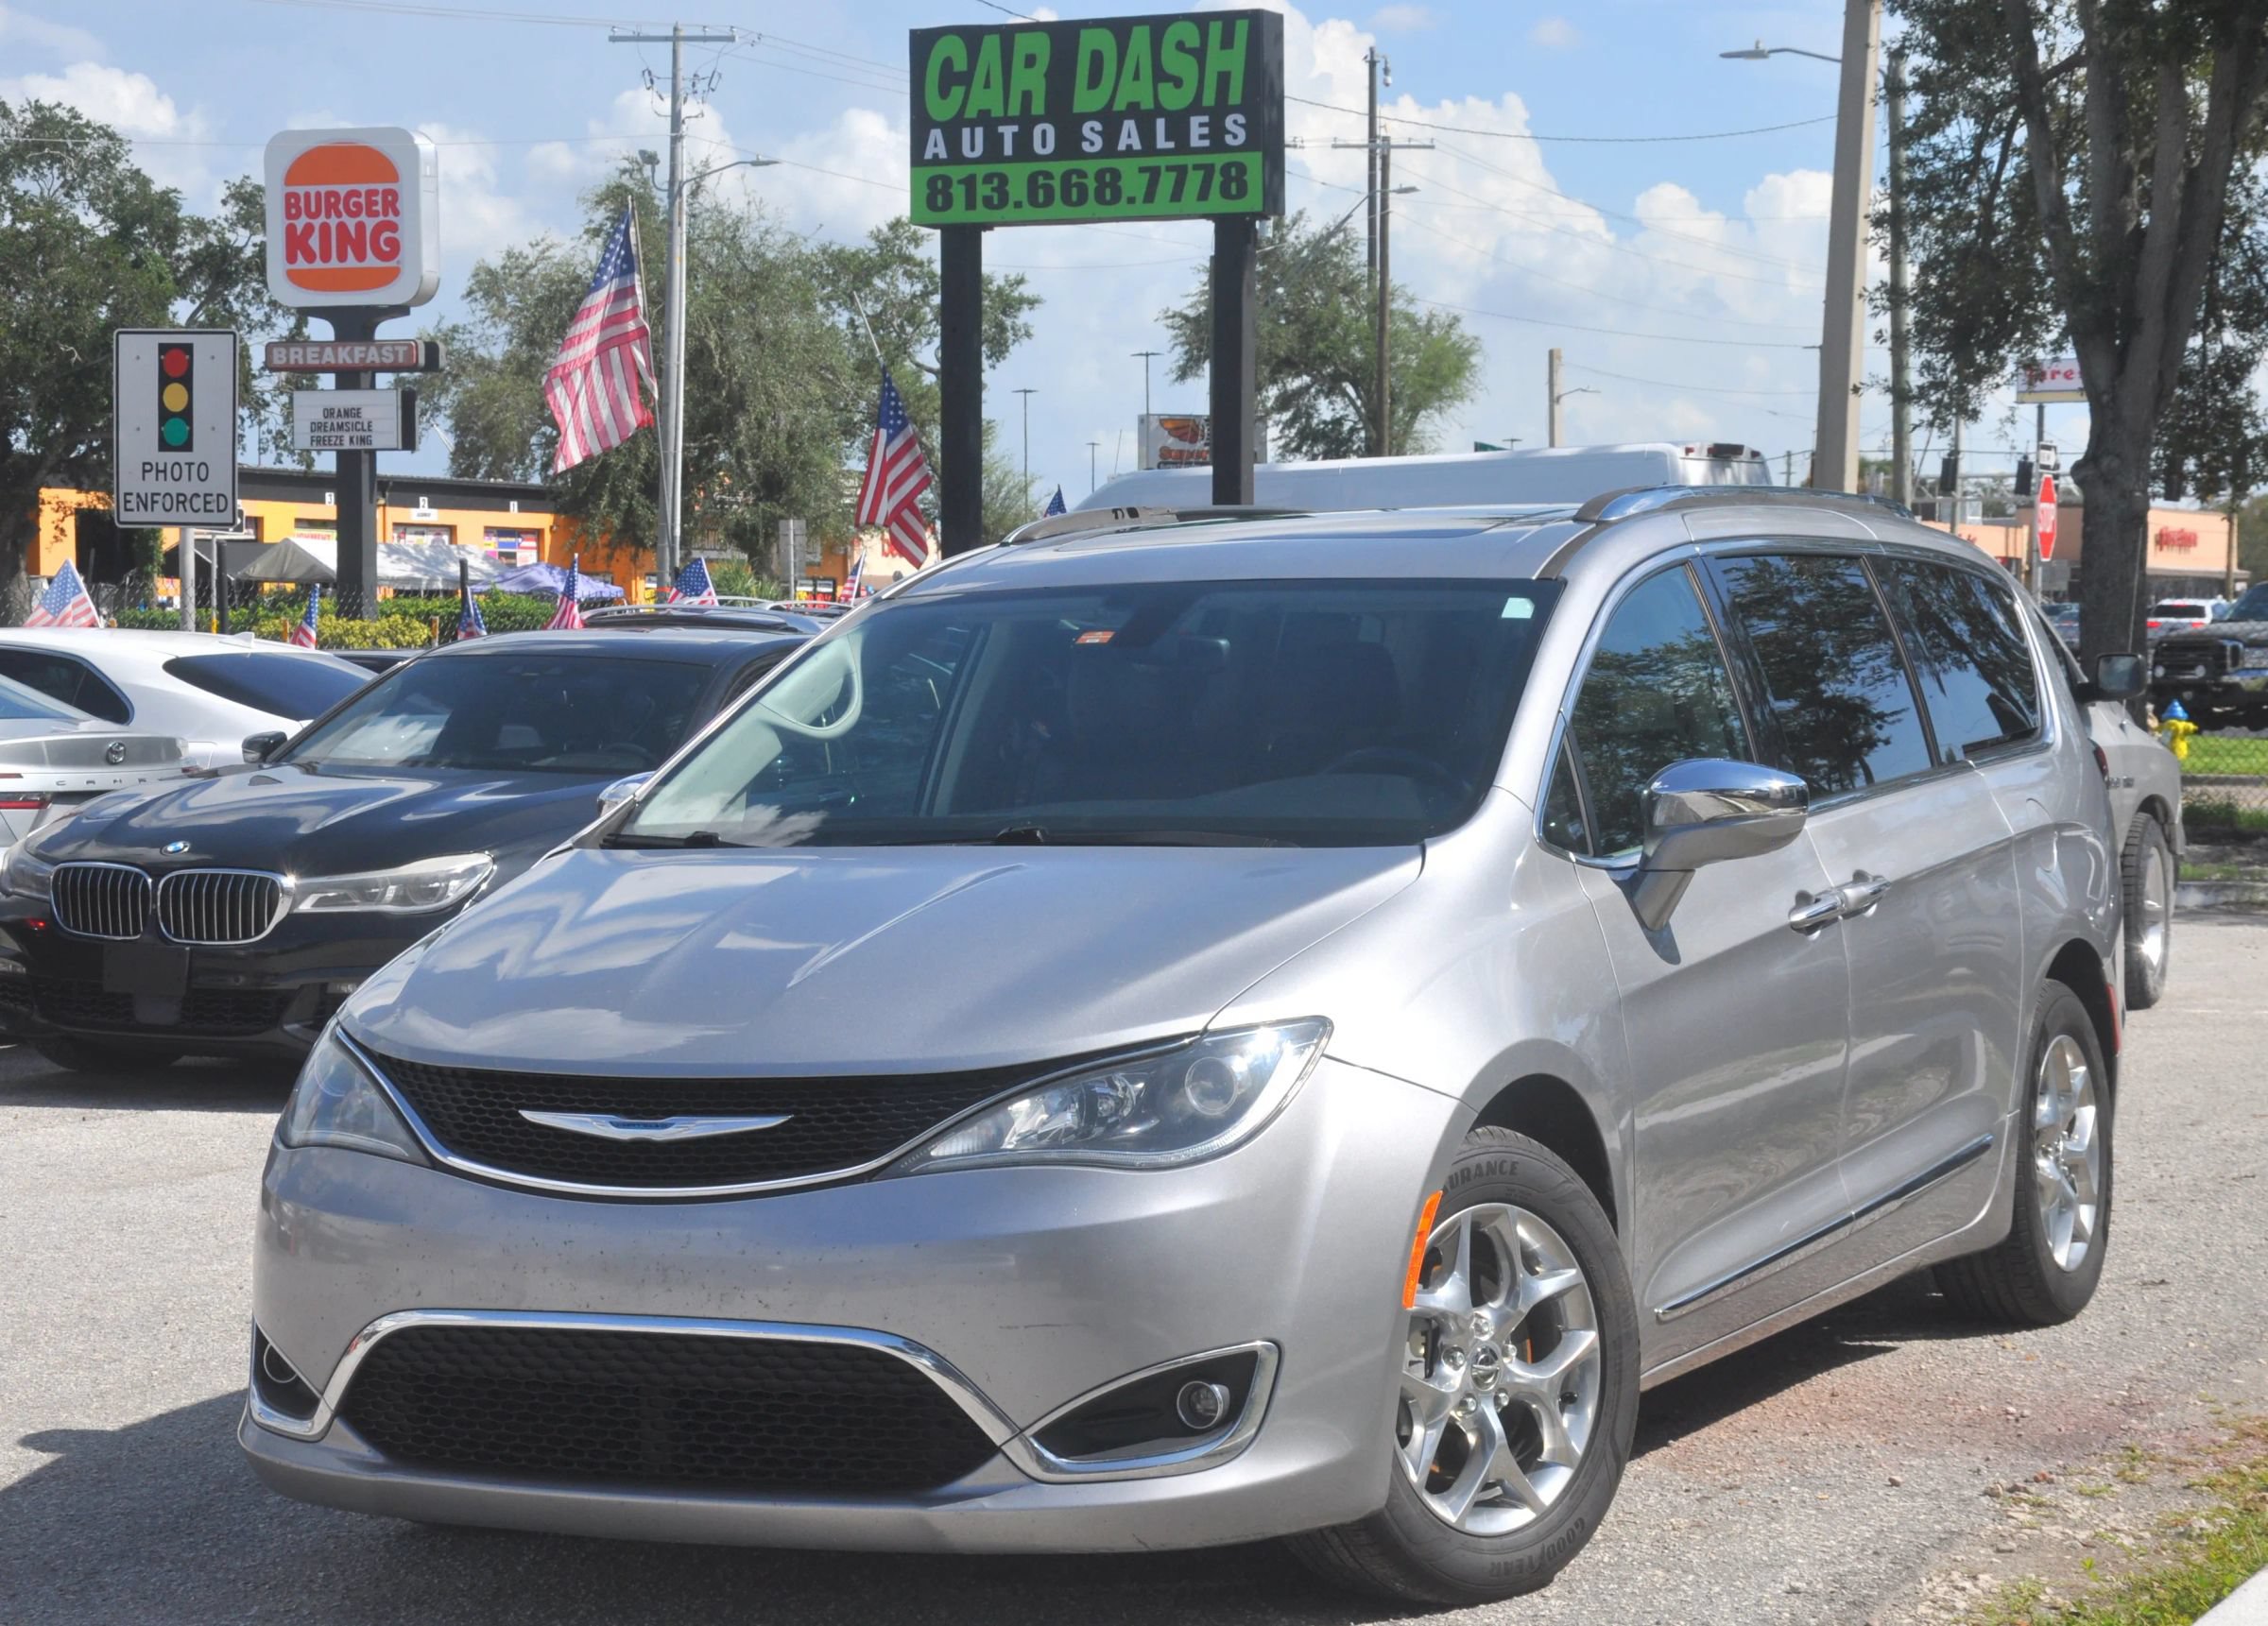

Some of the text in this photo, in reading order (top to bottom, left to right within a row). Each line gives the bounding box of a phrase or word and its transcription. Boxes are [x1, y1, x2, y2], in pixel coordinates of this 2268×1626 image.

[924, 19, 1249, 122] CAR DASH
[923, 113, 1247, 160] AUTO SALES
[925, 161, 1248, 213] 813.668.7778
[284, 188, 401, 220] BURGER
[285, 220, 401, 265] KING
[272, 346, 408, 365] BREAKFAST
[310, 421, 372, 433] DREAMSICLE
[322, 407, 363, 419] ORANGE
[310, 435, 372, 446] FREEZE KING
[142, 462, 209, 482] PHOTO
[123, 492, 229, 513] ENFORCED
[1443, 1159, 1520, 1192] URANCE
[1490, 1517, 1585, 1578] GOODYEAR
